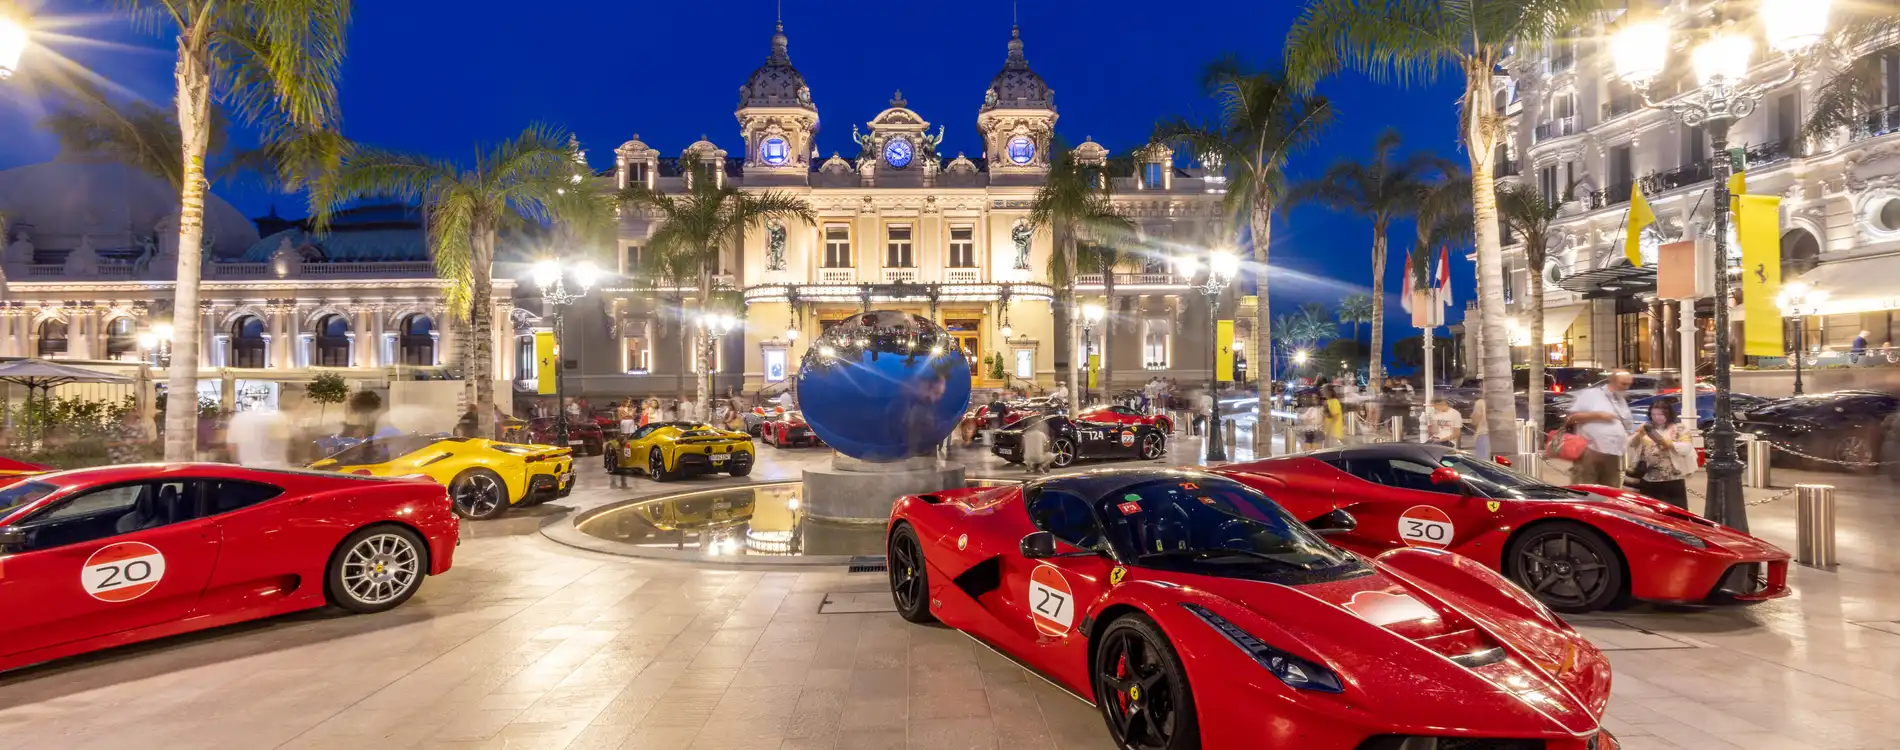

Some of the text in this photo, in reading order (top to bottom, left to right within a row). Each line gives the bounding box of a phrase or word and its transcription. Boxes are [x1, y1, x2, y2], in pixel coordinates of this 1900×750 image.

[1089, 431, 1104, 440] 124
[1406, 520, 1444, 541] 30
[96, 561, 151, 589] 20
[1036, 587, 1065, 618] 27
